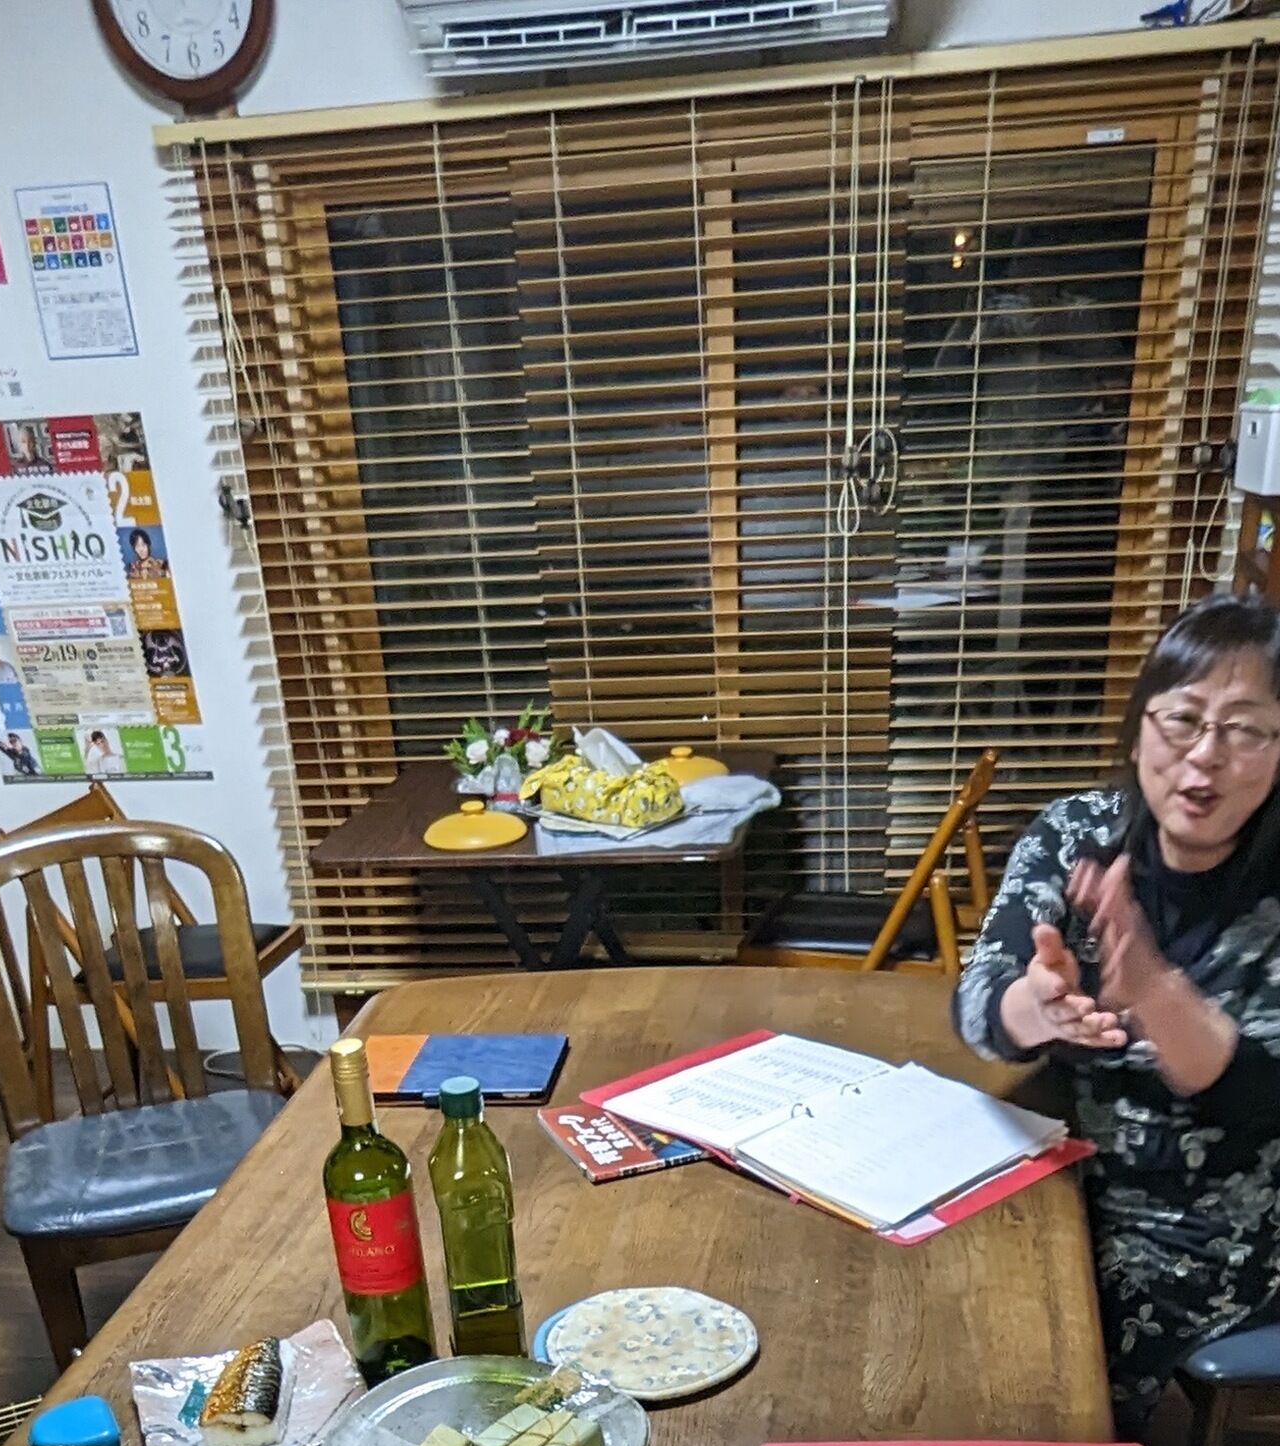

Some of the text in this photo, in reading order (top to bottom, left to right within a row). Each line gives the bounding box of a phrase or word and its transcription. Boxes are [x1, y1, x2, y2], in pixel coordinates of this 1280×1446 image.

[136, 10, 151, 38] 8
[161, 34, 171, 63] 7
[187, 41, 201, 69] 6
[108, 471, 137, 528] 2
[161, 725, 186, 773] 3
